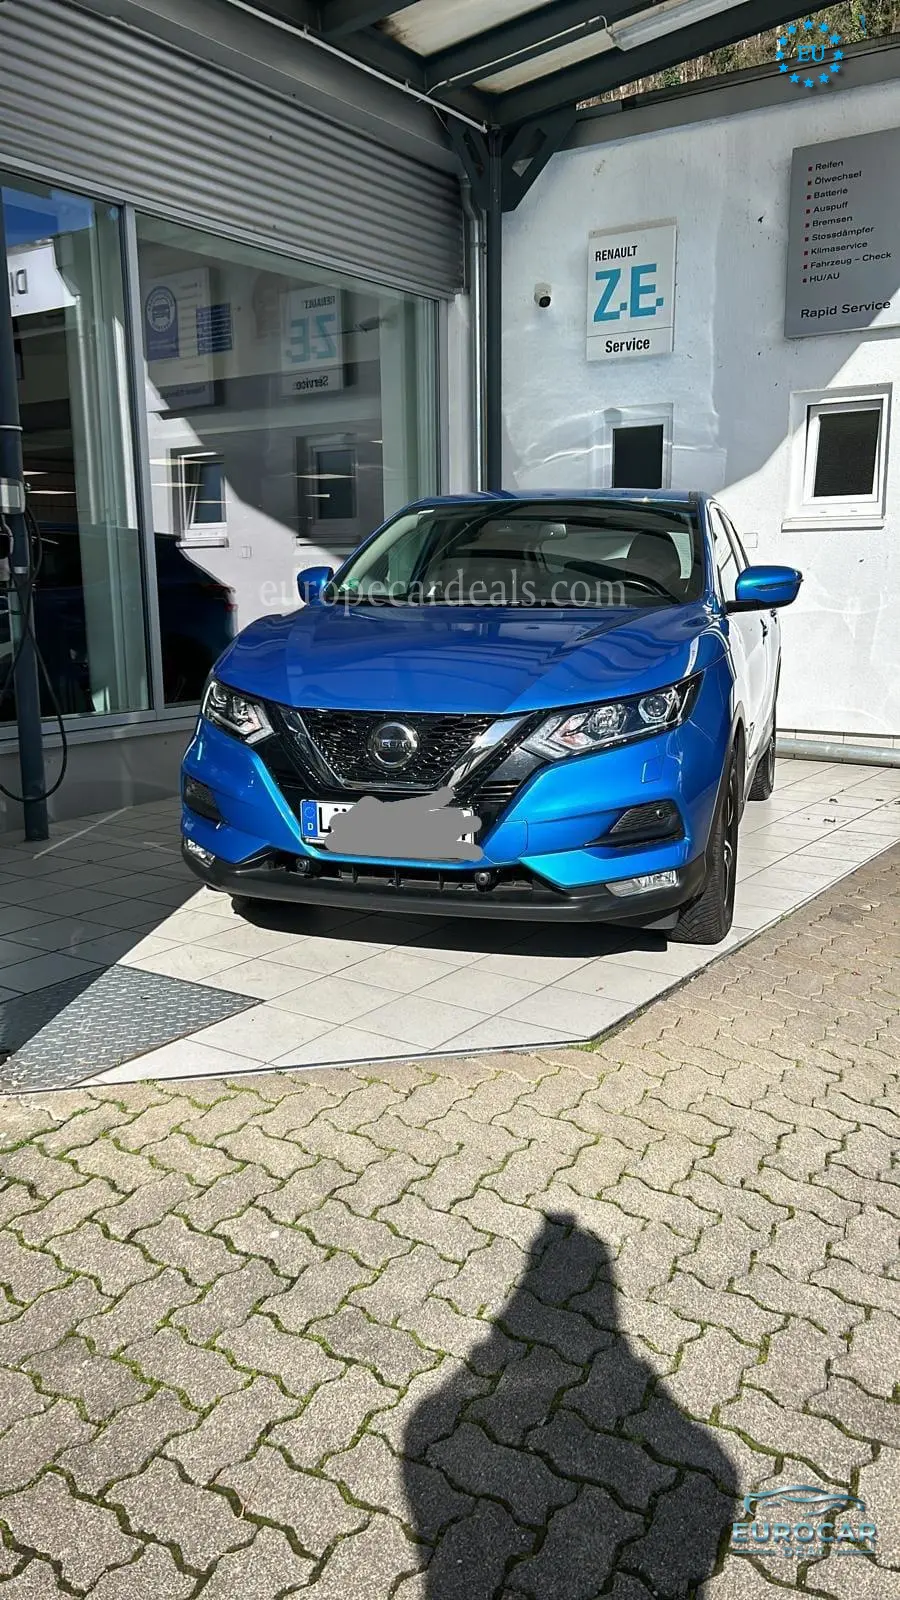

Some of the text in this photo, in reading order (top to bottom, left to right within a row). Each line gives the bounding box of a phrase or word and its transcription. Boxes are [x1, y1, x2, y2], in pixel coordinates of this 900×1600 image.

[815, 160, 844, 171] Reifen
[814, 170, 862, 185] Ölwechsel
[813, 187, 848, 199] Batterie
[813, 201, 848, 213] Auspuff
[812, 215, 853, 227] Bremsen
[811, 226, 874, 241] Stossdämpfer
[595, 245, 638, 261] RENAULT
[810, 241, 868, 255] Klimaservice
[810, 258, 852, 269] Fahrzeug
[862, 251, 892, 262] Check
[809, 271, 840, 283] HU/AU
[593, 263, 664, 322] Z.E.
[800, 300, 891, 318] Rapid Service
[605, 337, 650, 353] Service
[307, 822, 314, 831] D
